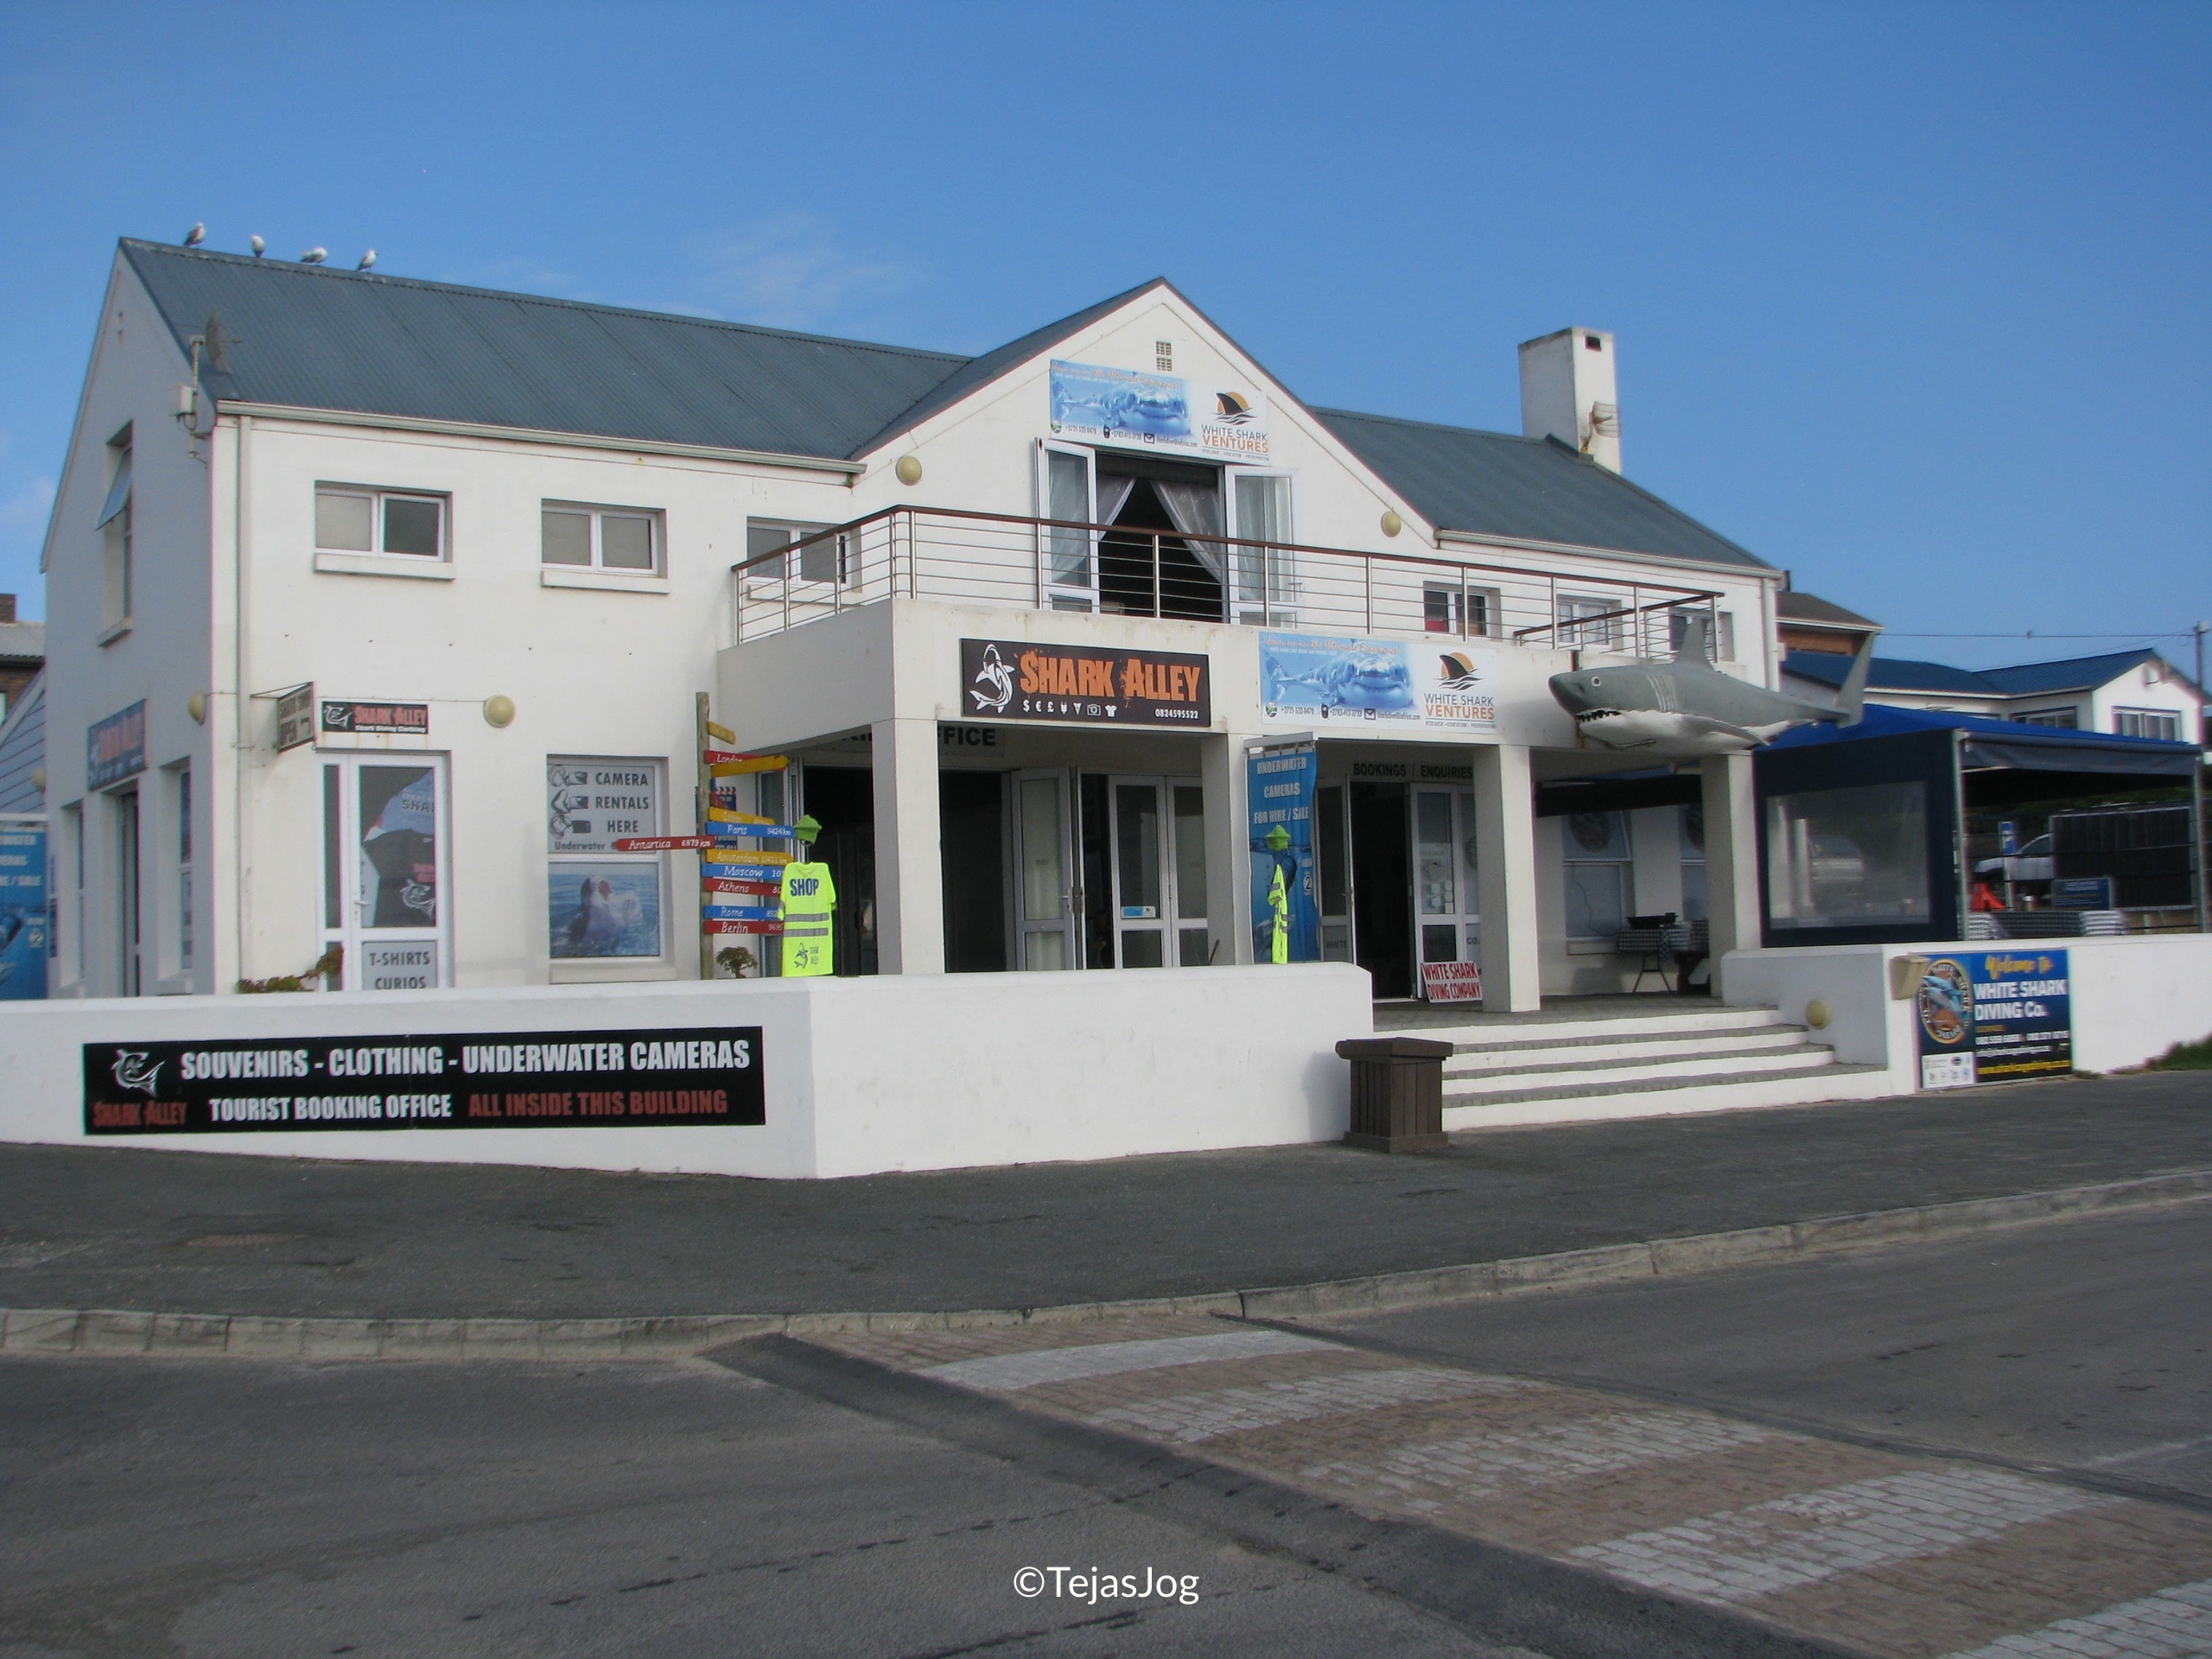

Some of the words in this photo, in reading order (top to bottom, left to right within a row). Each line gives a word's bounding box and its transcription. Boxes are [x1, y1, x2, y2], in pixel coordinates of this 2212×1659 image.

[1201, 424, 1233, 437] WHITE
[1236, 429, 1268, 442] SHARK
[1202, 434, 1268, 454] VENTURES
[1020, 650, 1116, 698] SHARK
[1122, 658, 1201, 702] ALLEY
[1424, 693, 1457, 705] WHITE
[1461, 696, 1494, 707] SHARK
[354, 706, 392, 726] SHARK
[393, 707, 427, 726] ALLEY
[1154, 708, 1198, 719] 0824595522
[1426, 704, 1494, 720] VENTURES
[938, 726, 995, 746] FICE
[1257, 757, 1306, 774] UNDERWATER
[1353, 763, 1407, 777] BOOKINGS
[1421, 765, 1473, 779] ENQUIRIES
[595, 772, 649, 786] CAMERA
[1264, 783, 1300, 798] CAMERAS
[401, 799, 435, 812] SHA
[595, 796, 650, 810] RENTALS
[1254, 810, 1268, 824] FOR
[1269, 810, 1286, 823] HIRE
[607, 820, 639, 833] HERE
[727, 825, 747, 835] Paris
[555, 842, 606, 852] Underwater
[628, 840, 671, 850] Antartica
[716, 853, 760, 863] Amsterdam
[724, 866, 763, 877] Moscow
[718, 882, 749, 893] Athens
[790, 878, 819, 897] SHOP
[721, 907, 744, 918] Rome
[721, 920, 749, 933] Berlin
[1326, 939, 1348, 949] WHITE
[369, 951, 430, 967] T-SHIRTS
[1425, 963, 1450, 981] WHITE
[1450, 962, 1478, 980] SHARK
[374, 976, 427, 990] CURIOS
[1974, 982, 2018, 1000] WHITE
[2019, 979, 2067, 997] SHARK
[1427, 983, 1450, 1001] DIVING
[1451, 982, 1482, 999] COMPANY
[1974, 1002, 2023, 1021] DIVING
[2024, 1001, 2049, 1019] Co.
[181, 1049, 309, 1080] SOUVENIRS
[328, 1045, 443, 1077] CLOTHING
[462, 1043, 625, 1074] UNDERWATER
[629, 1039, 751, 1071] CAMERAS
[208, 1096, 290, 1122] TOURIST
[295, 1095, 382, 1122] BOOKING
[385, 1094, 453, 1120] OFFICE
[468, 1094, 502, 1118] ALL
[505, 1092, 573, 1117] INSIDE
[577, 1091, 626, 1116] THIS
[629, 1090, 728, 1116] BUILDING
[92, 1100, 142, 1127] SHARK
[143, 1100, 188, 1128] ALLEY
